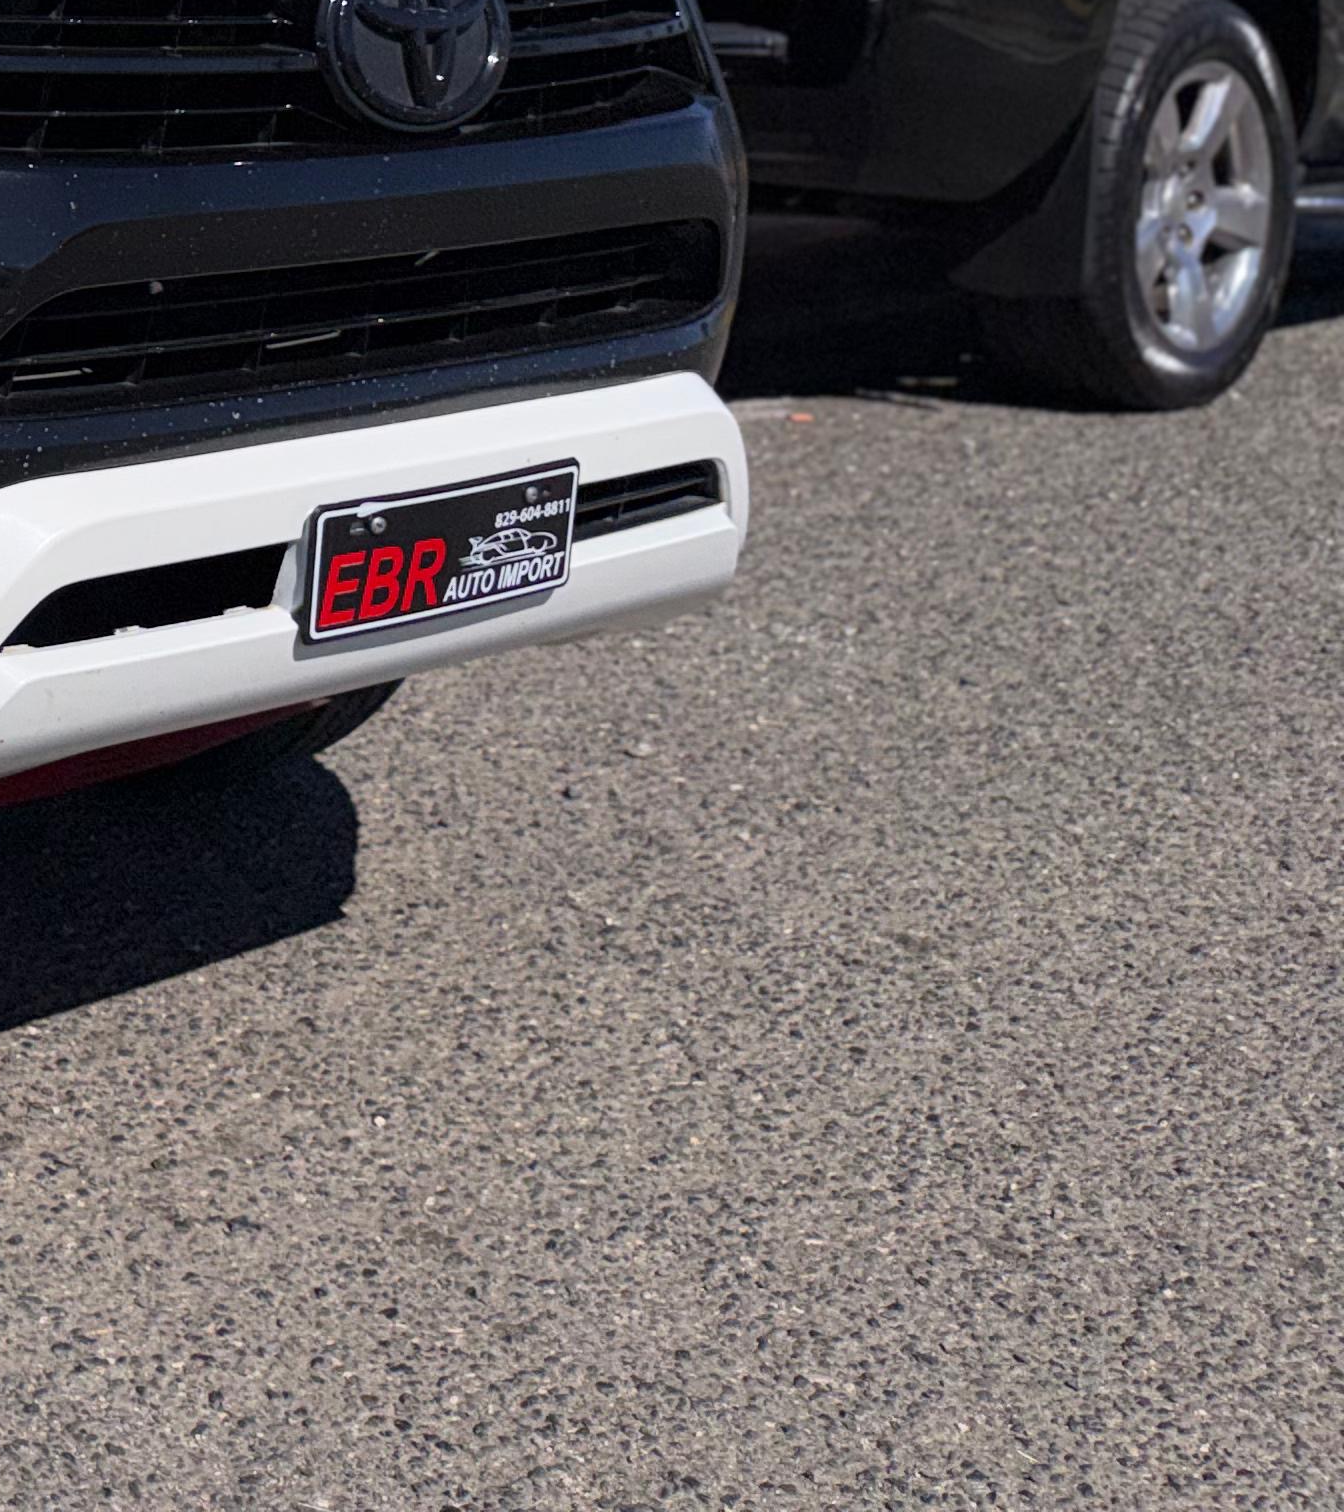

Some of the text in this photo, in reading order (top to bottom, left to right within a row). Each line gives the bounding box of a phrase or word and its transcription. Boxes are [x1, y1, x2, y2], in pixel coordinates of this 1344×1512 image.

[318, 538, 446, 628] EBR
[442, 550, 565, 604] AUTO IMPORT
